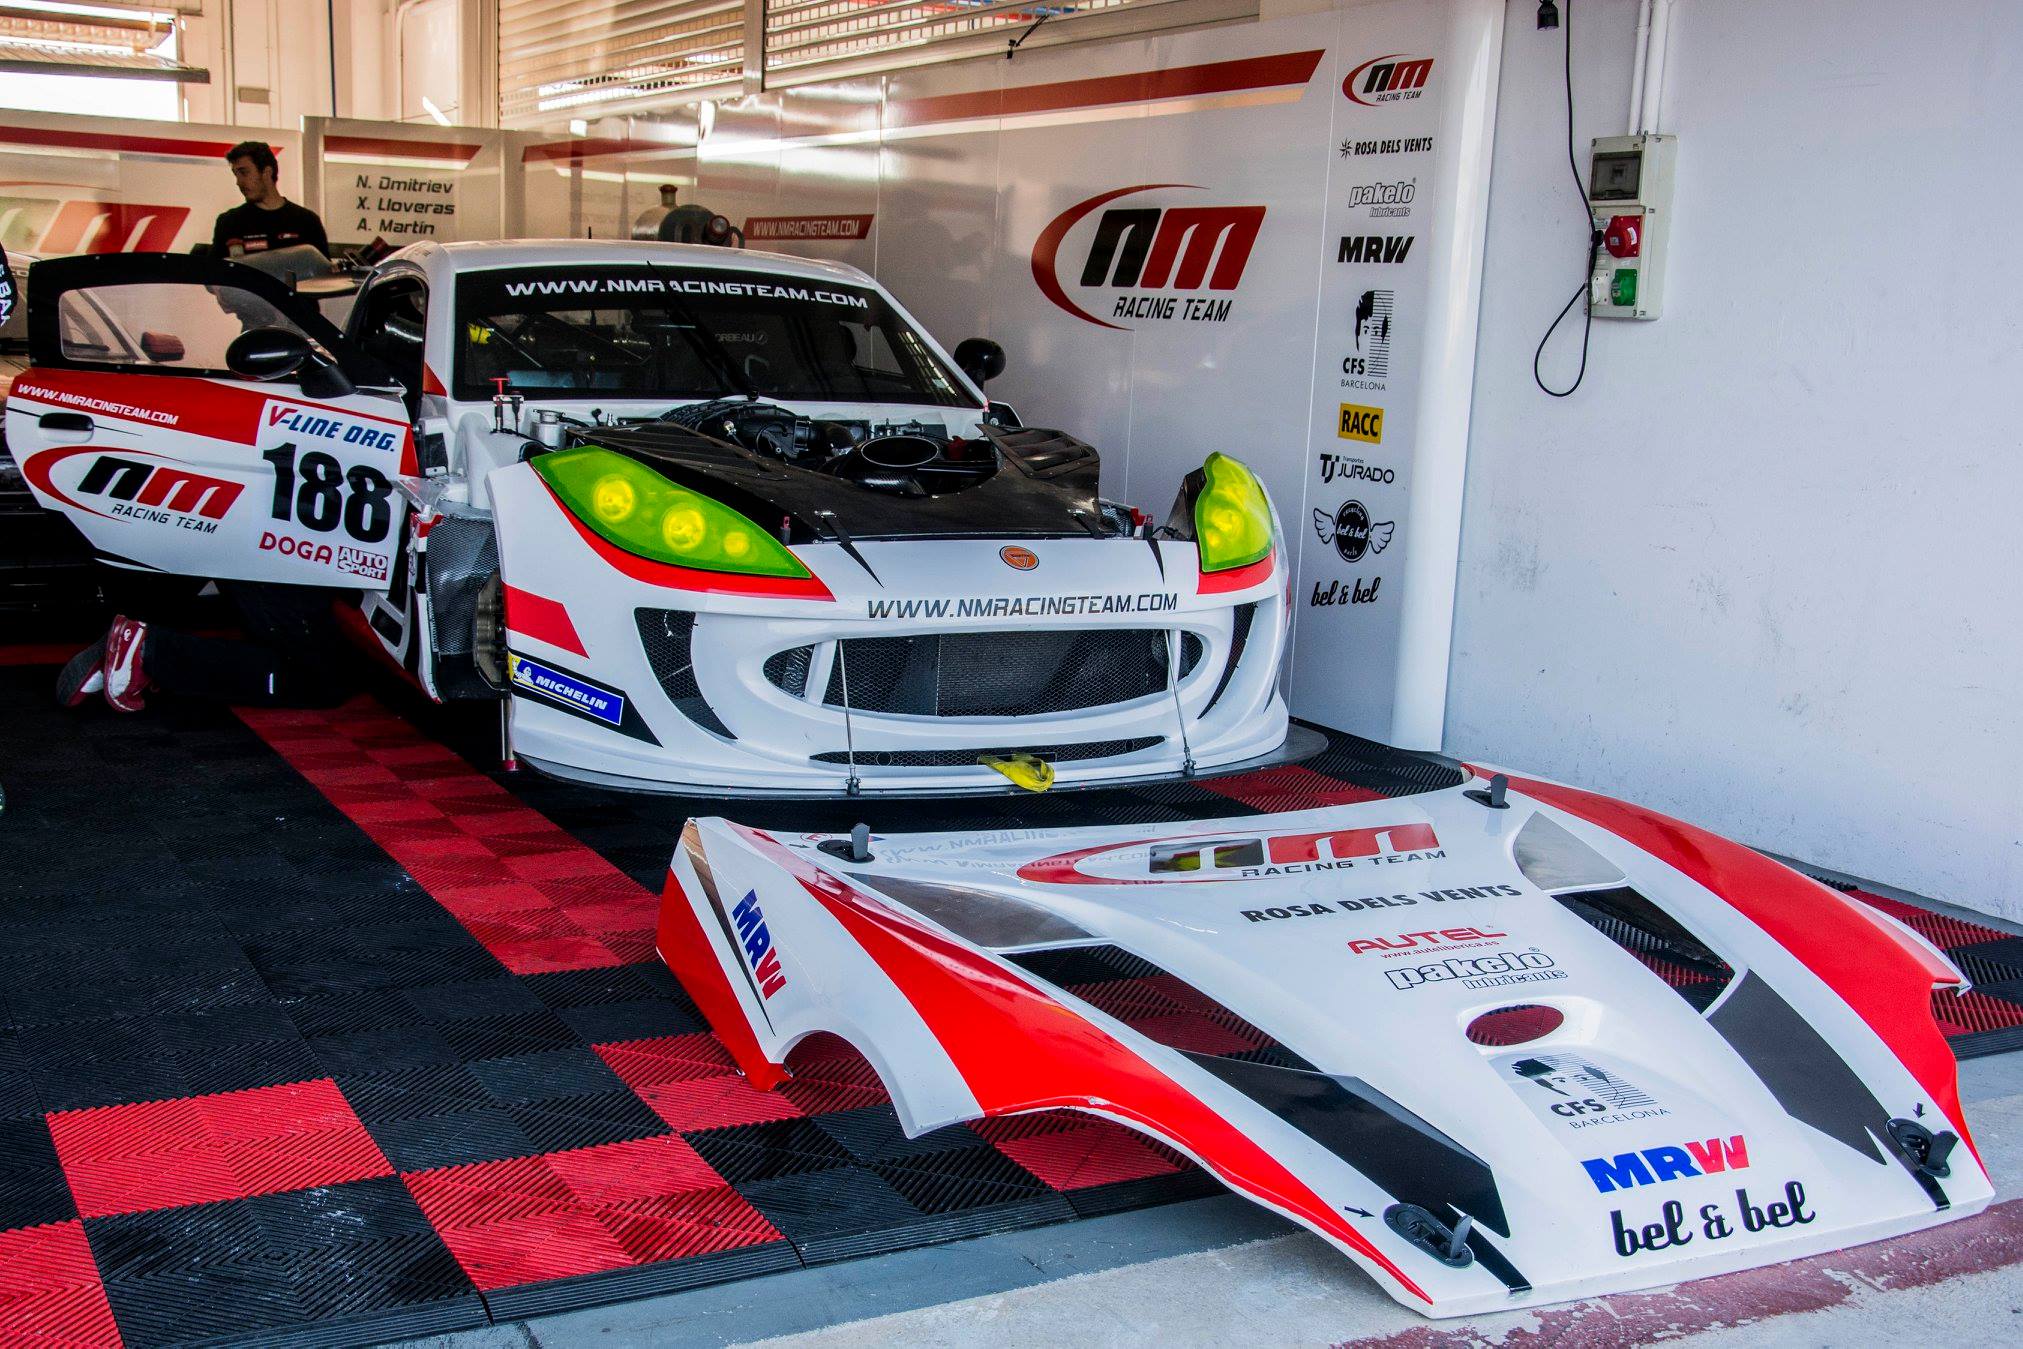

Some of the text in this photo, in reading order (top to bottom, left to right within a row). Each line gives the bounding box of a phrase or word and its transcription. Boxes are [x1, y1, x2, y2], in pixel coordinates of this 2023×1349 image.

[1376, 90, 1422, 102] RACING TEAM
[1354, 137, 1433, 155] ROSA DELS VENTS
[356, 175, 453, 193] N. Dmitriev
[1348, 180, 1415, 208] pakelo
[356, 196, 455, 215] X. Lloveras
[357, 218, 372, 231] A.
[753, 219, 859, 237] WWW.NMRACINGTEAM.COM
[1337, 236, 1415, 264] MRW
[505, 280, 868, 309] WWW.NMRACINGTEAM.COM
[1112, 296, 1234, 322] RACING TEAM
[1343, 357, 1365, 375] CFS
[1340, 379, 1386, 391] BARCELONA
[17, 383, 179, 425] WWW.NMRACINGTEAM.COM
[1341, 409, 1379, 437] RACC
[343, 425, 396, 452] ORG.
[1338, 463, 1395, 484] JURADO
[263, 442, 393, 543] 188
[111, 504, 219, 535] RACING TEAM
[258, 531, 333, 565] DOGA
[339, 547, 388, 570] AUTO
[338, 560, 387, 580] SPORT
[1311, 577, 1381, 607] bel & bel
[868, 593, 1178, 619] WWW.NMRACINGTEAM.COM
[535, 675, 608, 710] MICHELIN
[1242, 850, 1447, 877] RACING TEAM
[1240, 884, 1523, 922] ROSA DELS VENTS
[732, 889, 787, 1000] MRW
[1347, 927, 1508, 955] AUTEL
[1381, 940, 1500, 959] www.auteliberica.es
[1384, 952, 1555, 990] pakelo
[1550, 1098, 1607, 1117] CFS
[1569, 1106, 1672, 1129] BARCELONA
[1580, 1134, 1750, 1194] MRW
[1610, 1181, 1816, 1257] bel & bel
